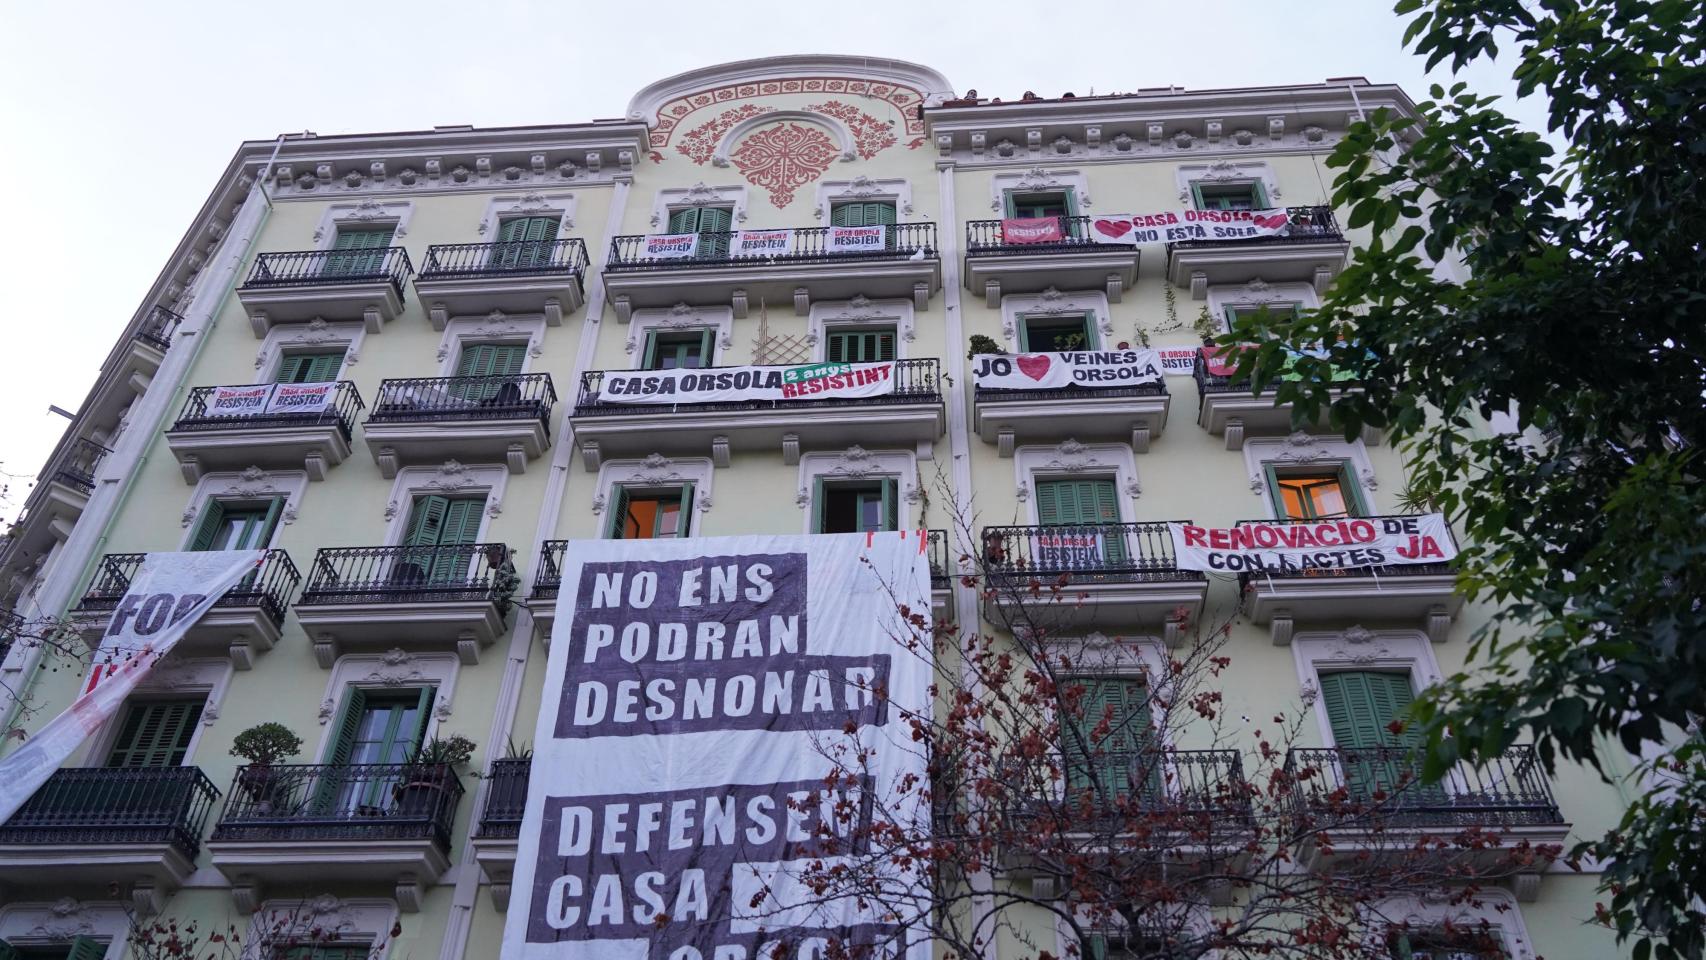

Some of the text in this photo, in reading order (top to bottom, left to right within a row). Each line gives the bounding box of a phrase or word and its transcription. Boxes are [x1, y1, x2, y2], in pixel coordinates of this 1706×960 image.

[1132, 210, 1253, 227] CASA ORSOLA
[834, 235, 880, 246] RESISTEIX
[854, 229, 880, 237] ORSOLA
[1135, 224, 1258, 242] NO ESTÀ SOLA
[647, 242, 692, 254] RESISTEIX
[741, 239, 787, 249] RESISTEIX
[1059, 351, 1138, 365] VEINES
[785, 364, 850, 380] 2 anys
[973, 358, 1012, 378] JO
[1072, 364, 1159, 382] ORSOLA
[607, 371, 782, 395] CASA ORSOLA
[781, 364, 892, 398] RESISTINT
[214, 397, 263, 409] RESISTEIX
[275, 394, 326, 406] RESISTEIX
[1384, 518, 1420, 535] DE
[1396, 536, 1445, 559] JA
[592, 564, 774, 608] NO ENS
[584, 615, 799, 663] PODRAN
[573, 667, 875, 726] DESNONAR
[546, 869, 708, 929] CASA
